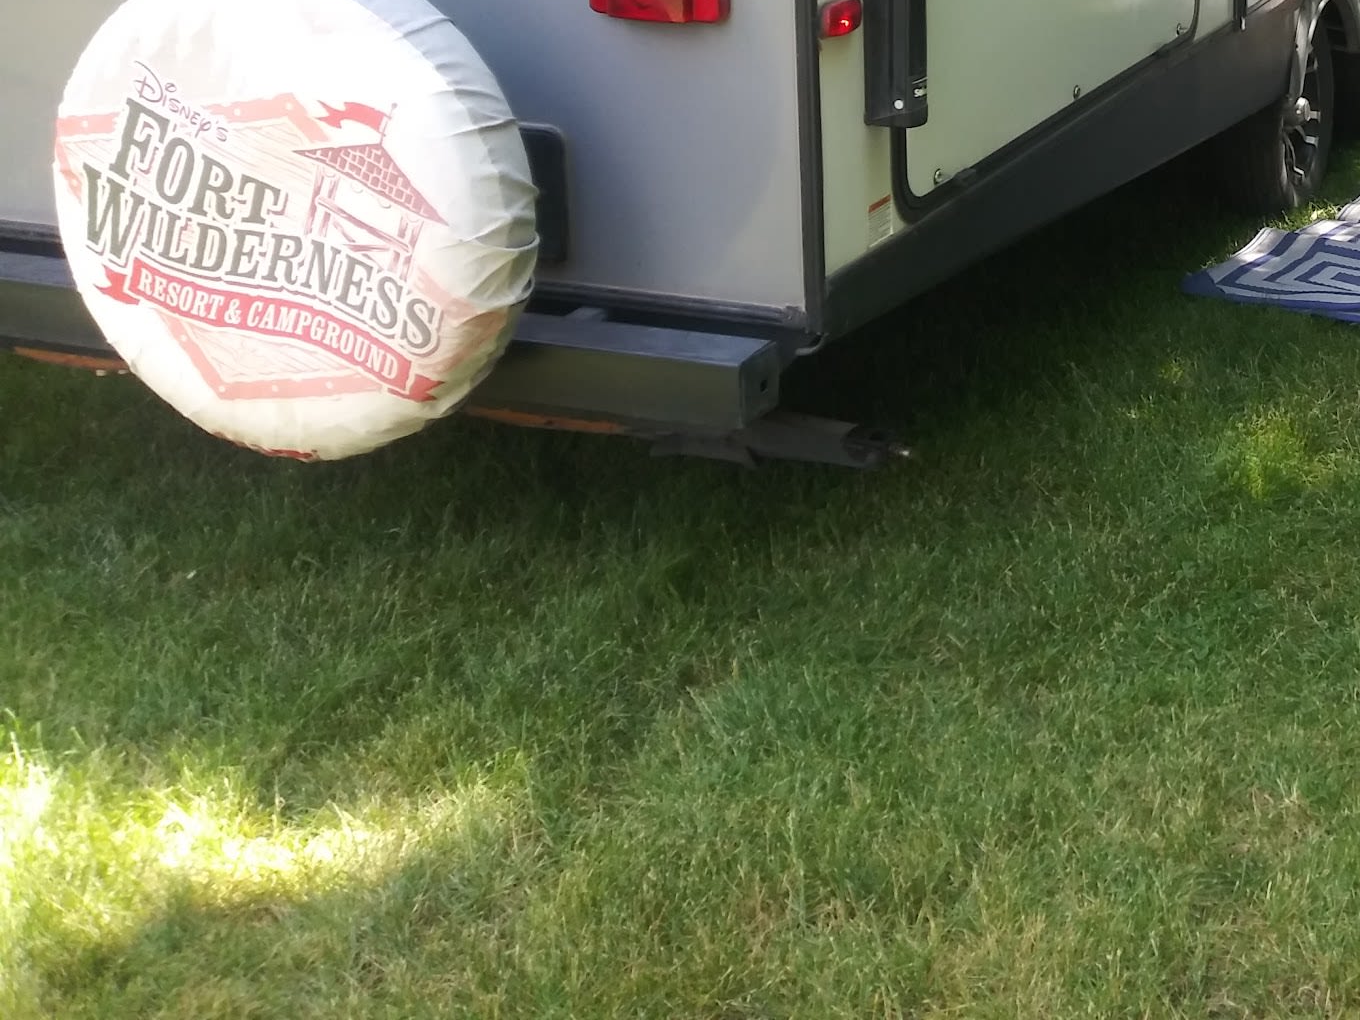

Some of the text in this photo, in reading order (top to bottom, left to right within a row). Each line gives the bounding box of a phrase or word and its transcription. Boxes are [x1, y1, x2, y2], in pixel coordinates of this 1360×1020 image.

[109, 97, 286, 227] FORT
[82, 162, 439, 350] WILDERNESS
[138, 267, 400, 379] RESORT & CAMPGROUND
